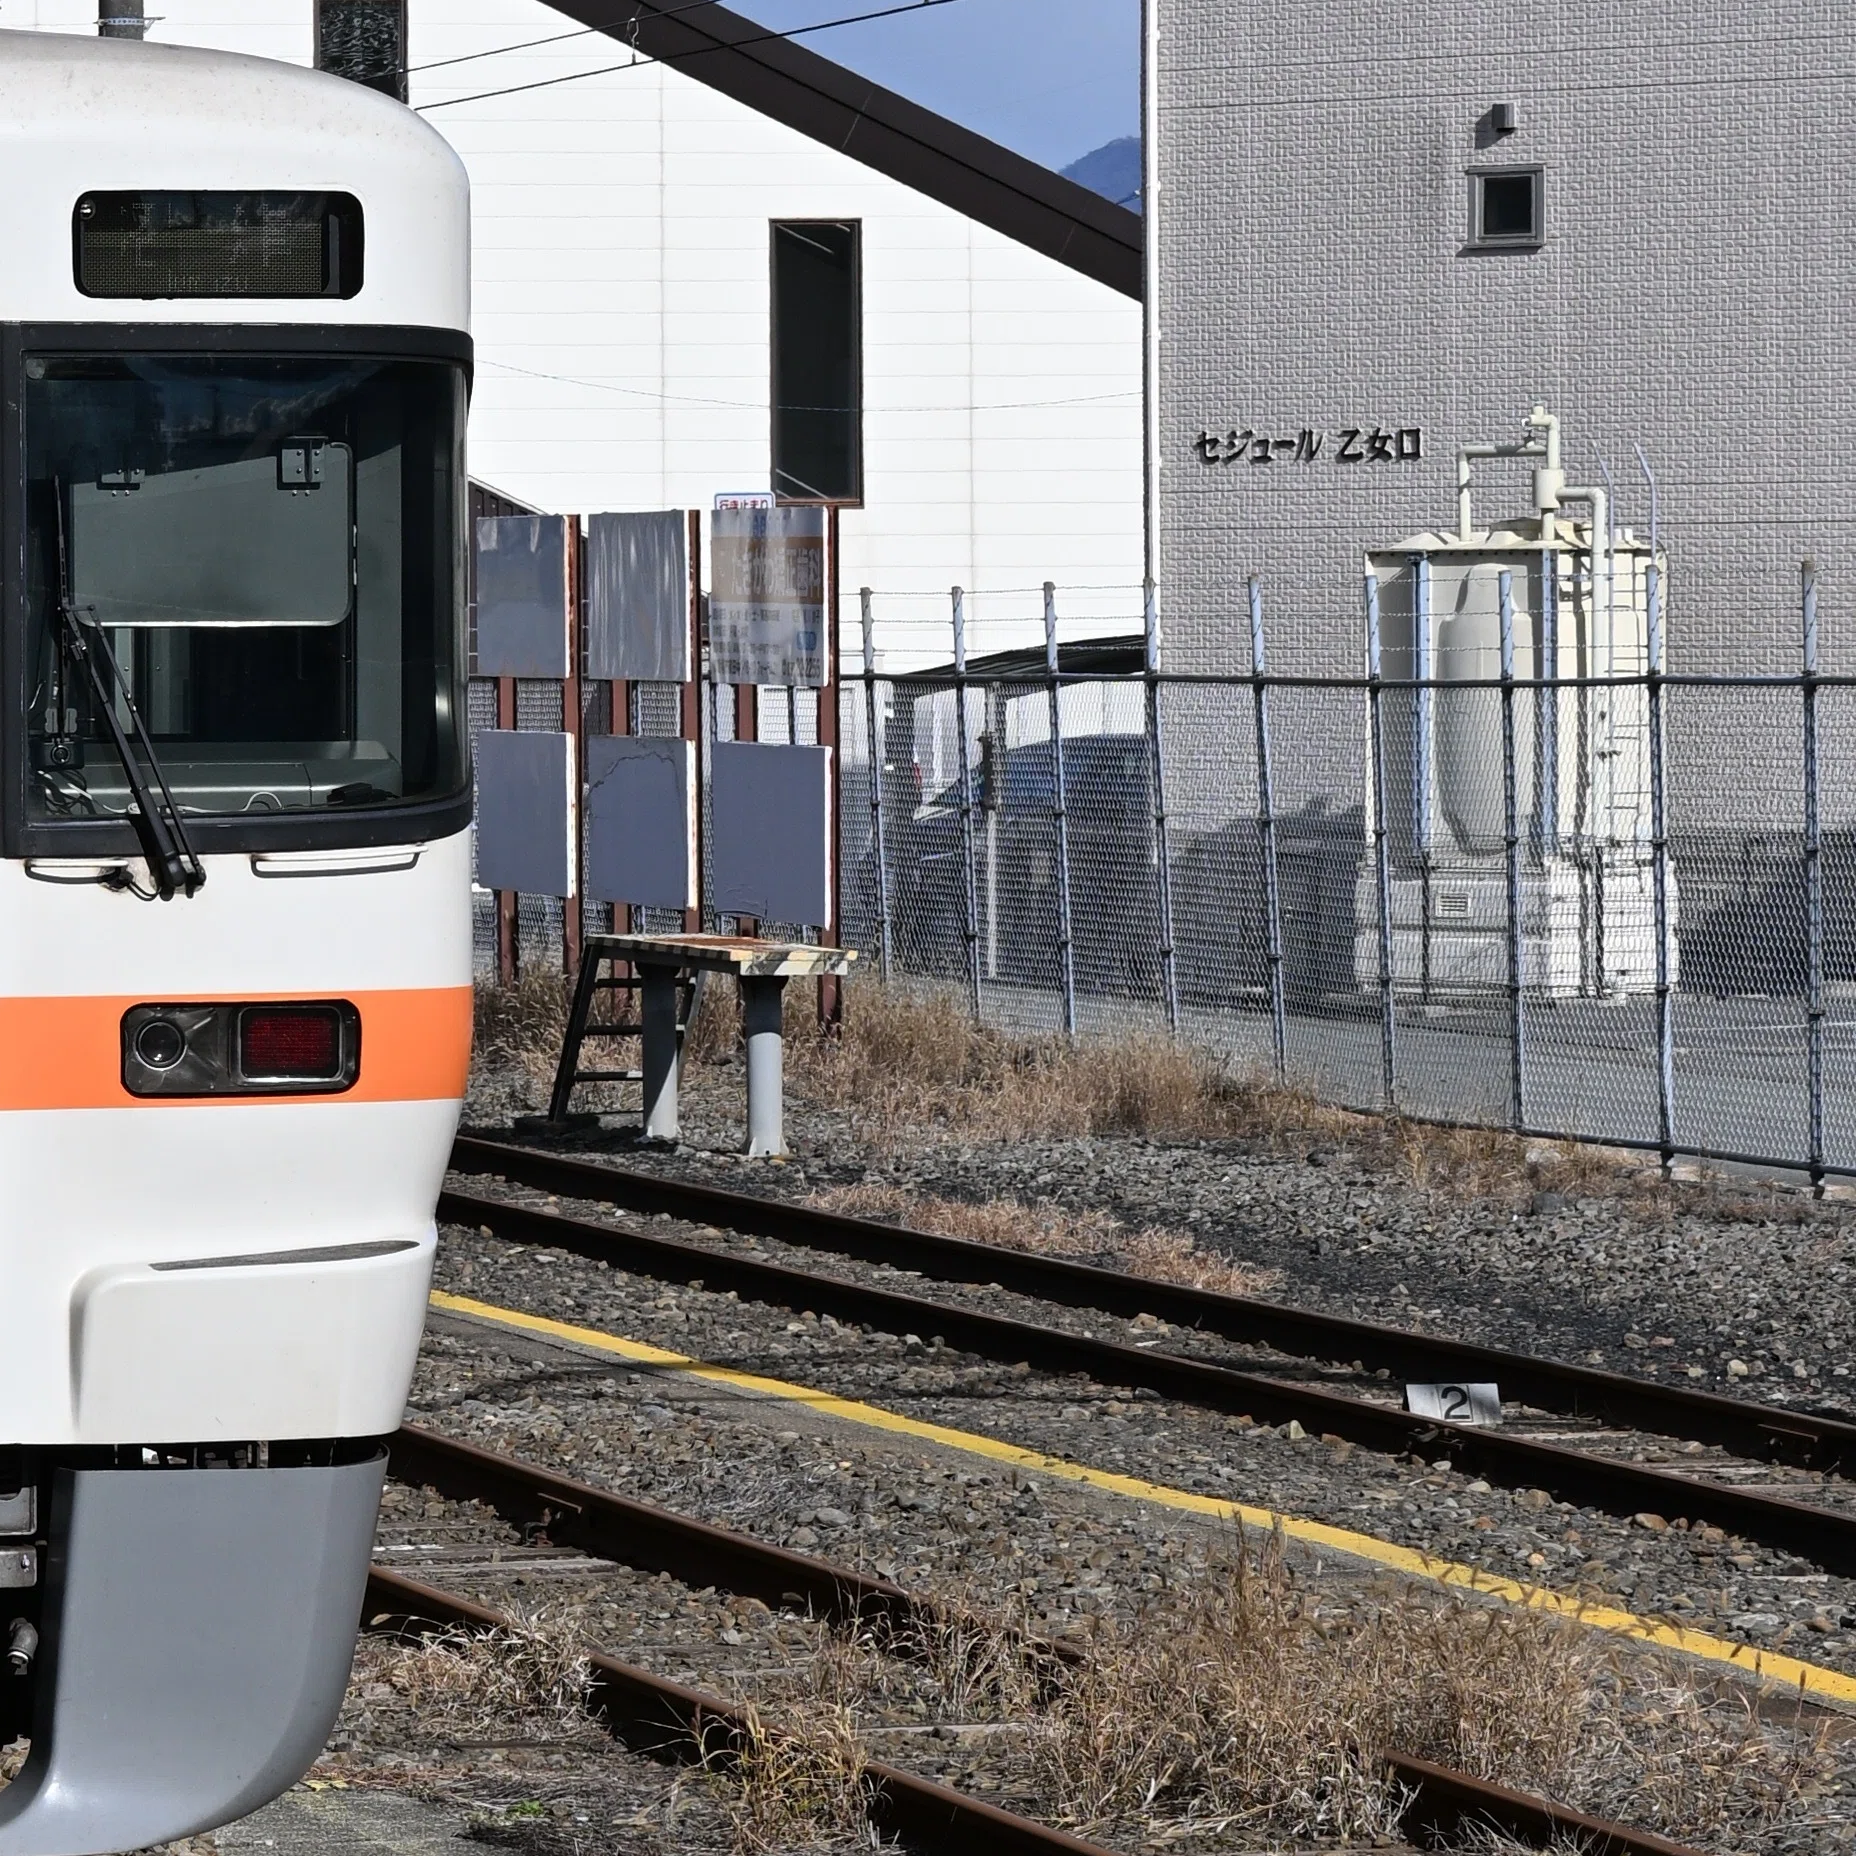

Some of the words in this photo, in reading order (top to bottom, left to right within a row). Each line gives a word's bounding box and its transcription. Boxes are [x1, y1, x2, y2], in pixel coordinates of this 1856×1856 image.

[1197, 427, 1322, 462] セジュール
[1338, 427, 1422, 462] 乙女口
[1441, 1385, 1471, 1420] 2
